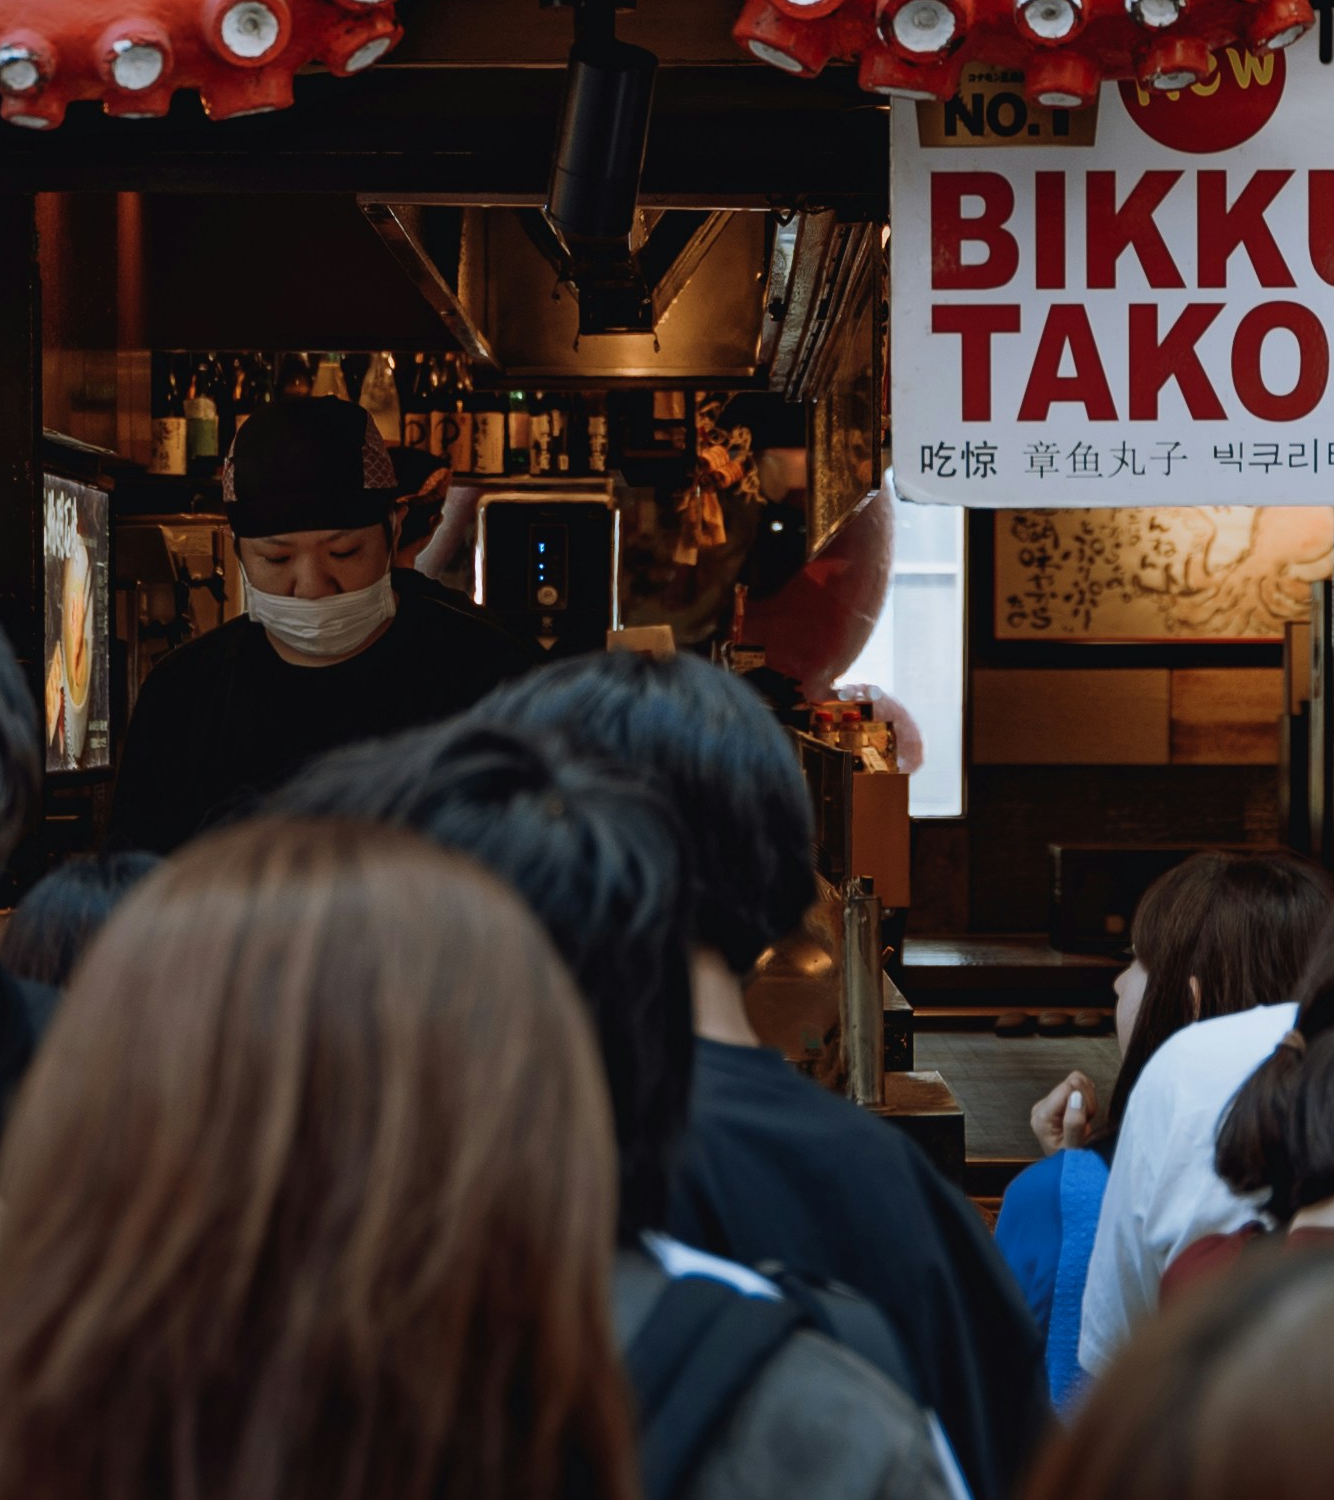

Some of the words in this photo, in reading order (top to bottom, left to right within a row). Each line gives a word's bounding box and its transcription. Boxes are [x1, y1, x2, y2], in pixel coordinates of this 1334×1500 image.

[919, 440, 1000, 479] 吃惊
[1022, 440, 1190, 479] 章鱼丸子
